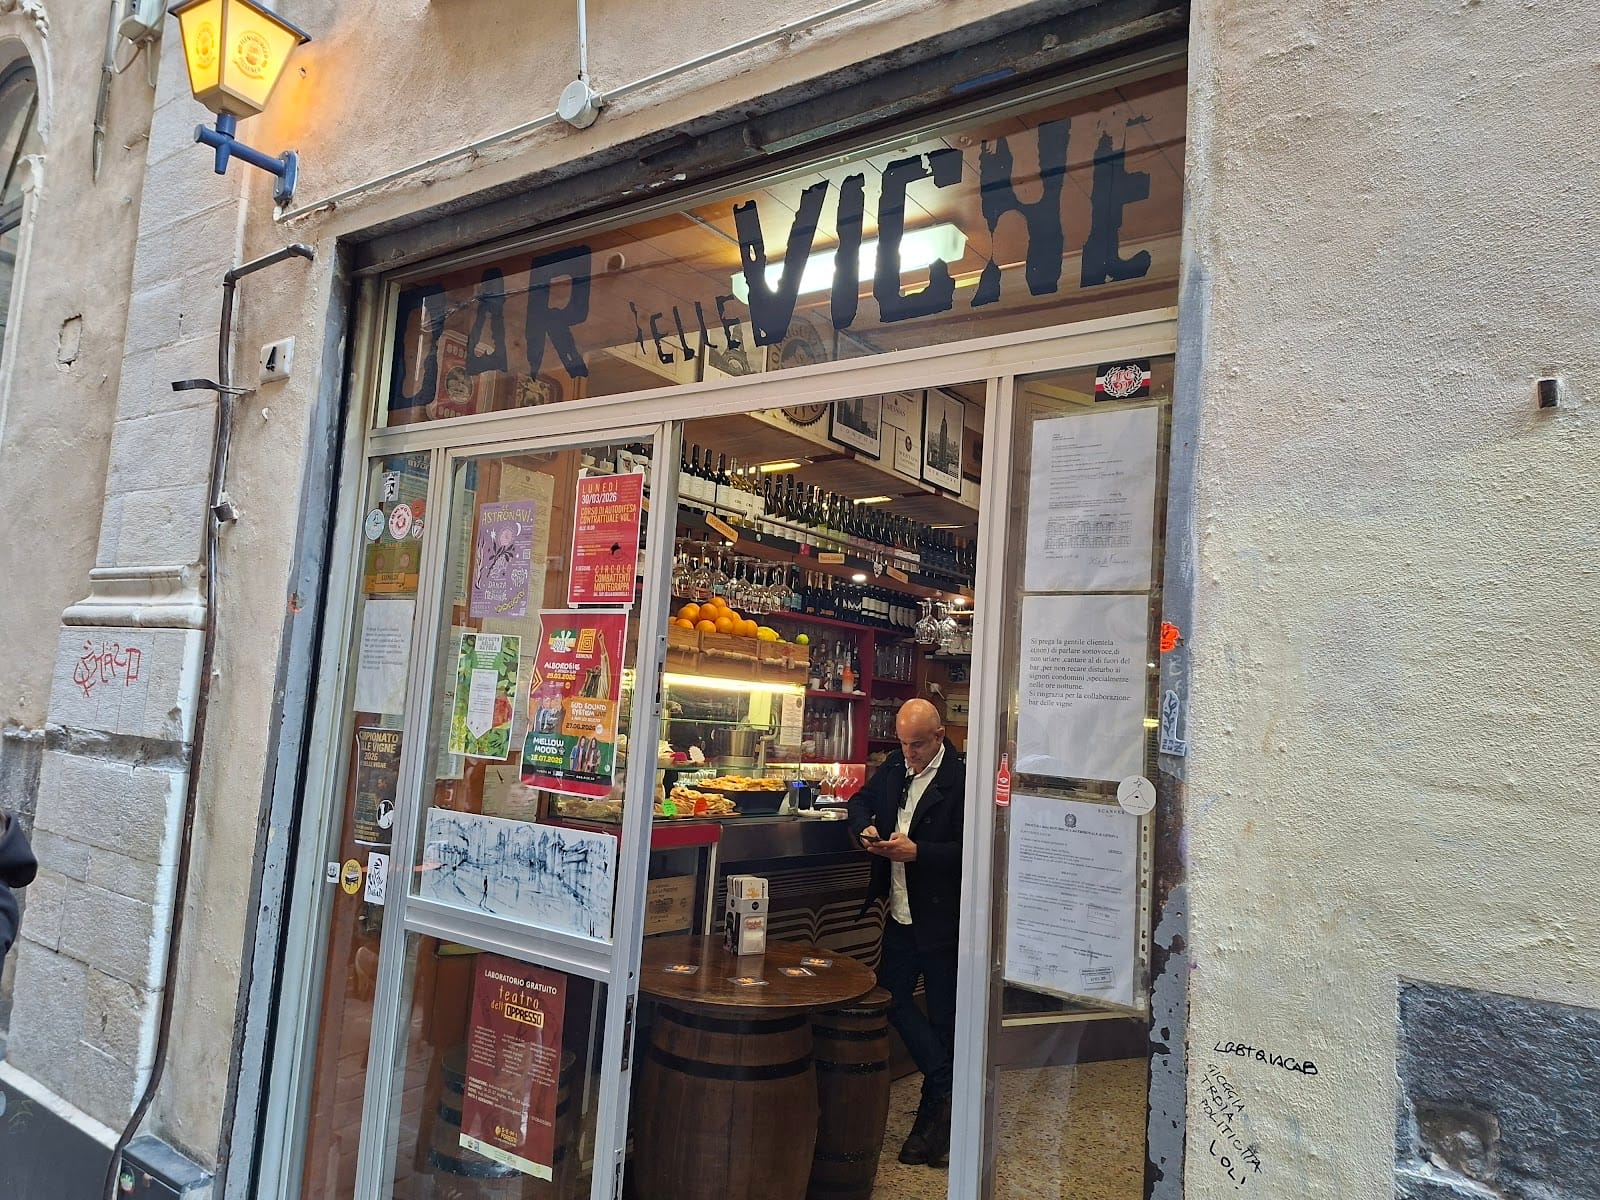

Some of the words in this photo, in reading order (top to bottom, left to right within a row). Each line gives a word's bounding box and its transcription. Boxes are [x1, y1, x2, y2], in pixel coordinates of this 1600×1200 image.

[629, 293, 741, 365] ELLE
[582, 492, 617, 504] 30/03/2026
[581, 506, 598, 516] CORSO
[604, 504, 636, 514] AUTODIFESA
[580, 514, 619, 524] CONTRATTUALE
[595, 564, 632, 574] CIRCOLO
[373, 742, 396, 753] VIGNE
[533, 737, 564, 747] MELLOW
[535, 745, 557, 754] MOOD
[484, 969, 524, 986] LABORATORIO
[526, 981, 557, 995] GRATUITO
[499, 985, 539, 1009] teatro
[506, 1006, 541, 1025] OPPRESSO
[1201, 1074, 1234, 1123] TROIA
